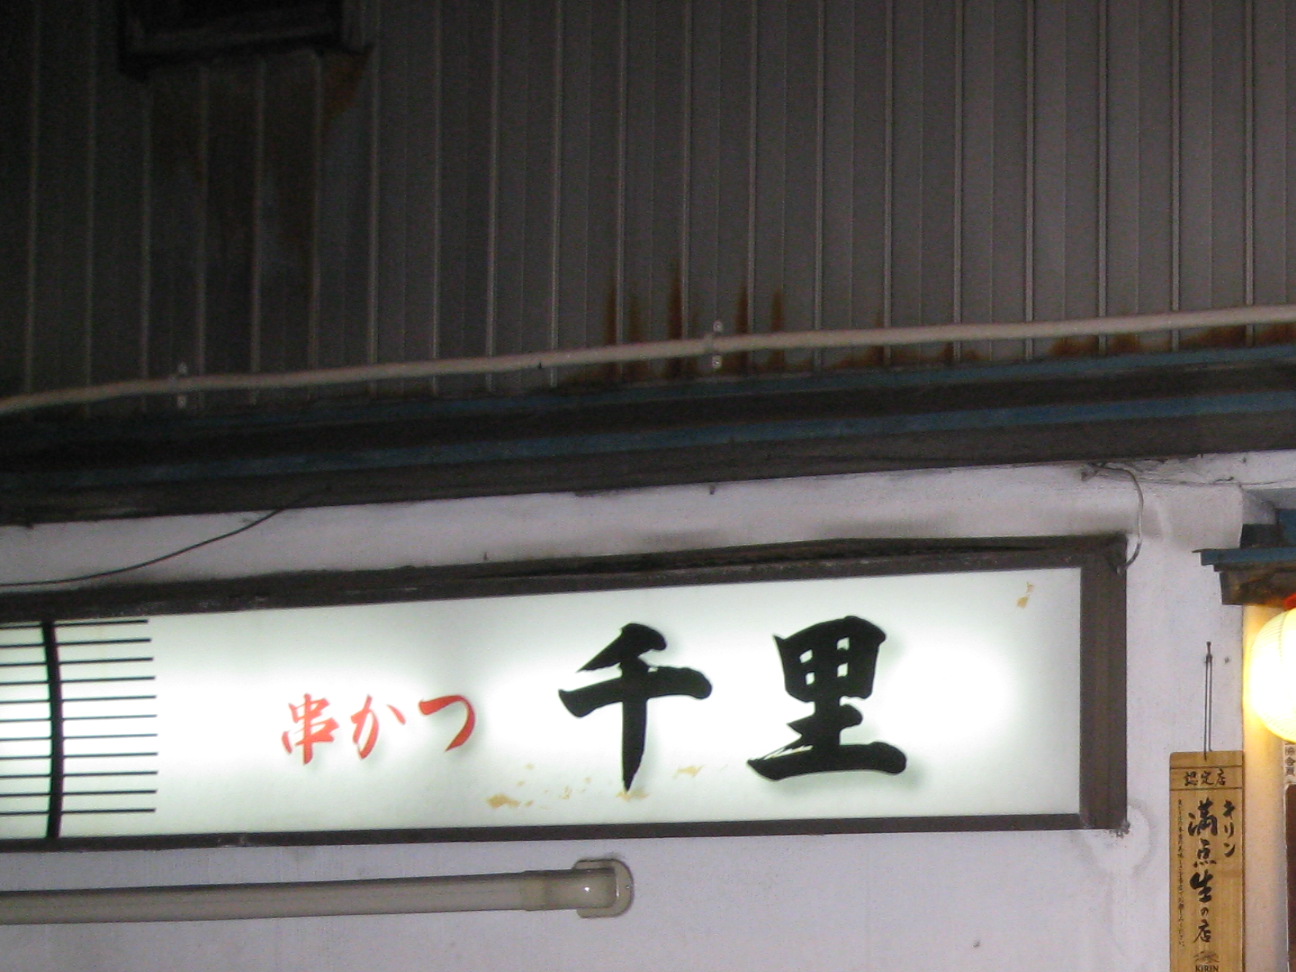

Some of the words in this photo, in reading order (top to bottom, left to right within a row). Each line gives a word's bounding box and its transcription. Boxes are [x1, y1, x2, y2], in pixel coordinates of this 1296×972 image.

[281, 692, 476, 765] 串かつ
[558, 615, 908, 791] 千里
[1184, 768, 1226, 787] 認定店
[1222, 799, 1236, 859] キリン
[1187, 796, 1218, 943] 満点生の店
[1195, 964, 1220, 972] KIRIN
